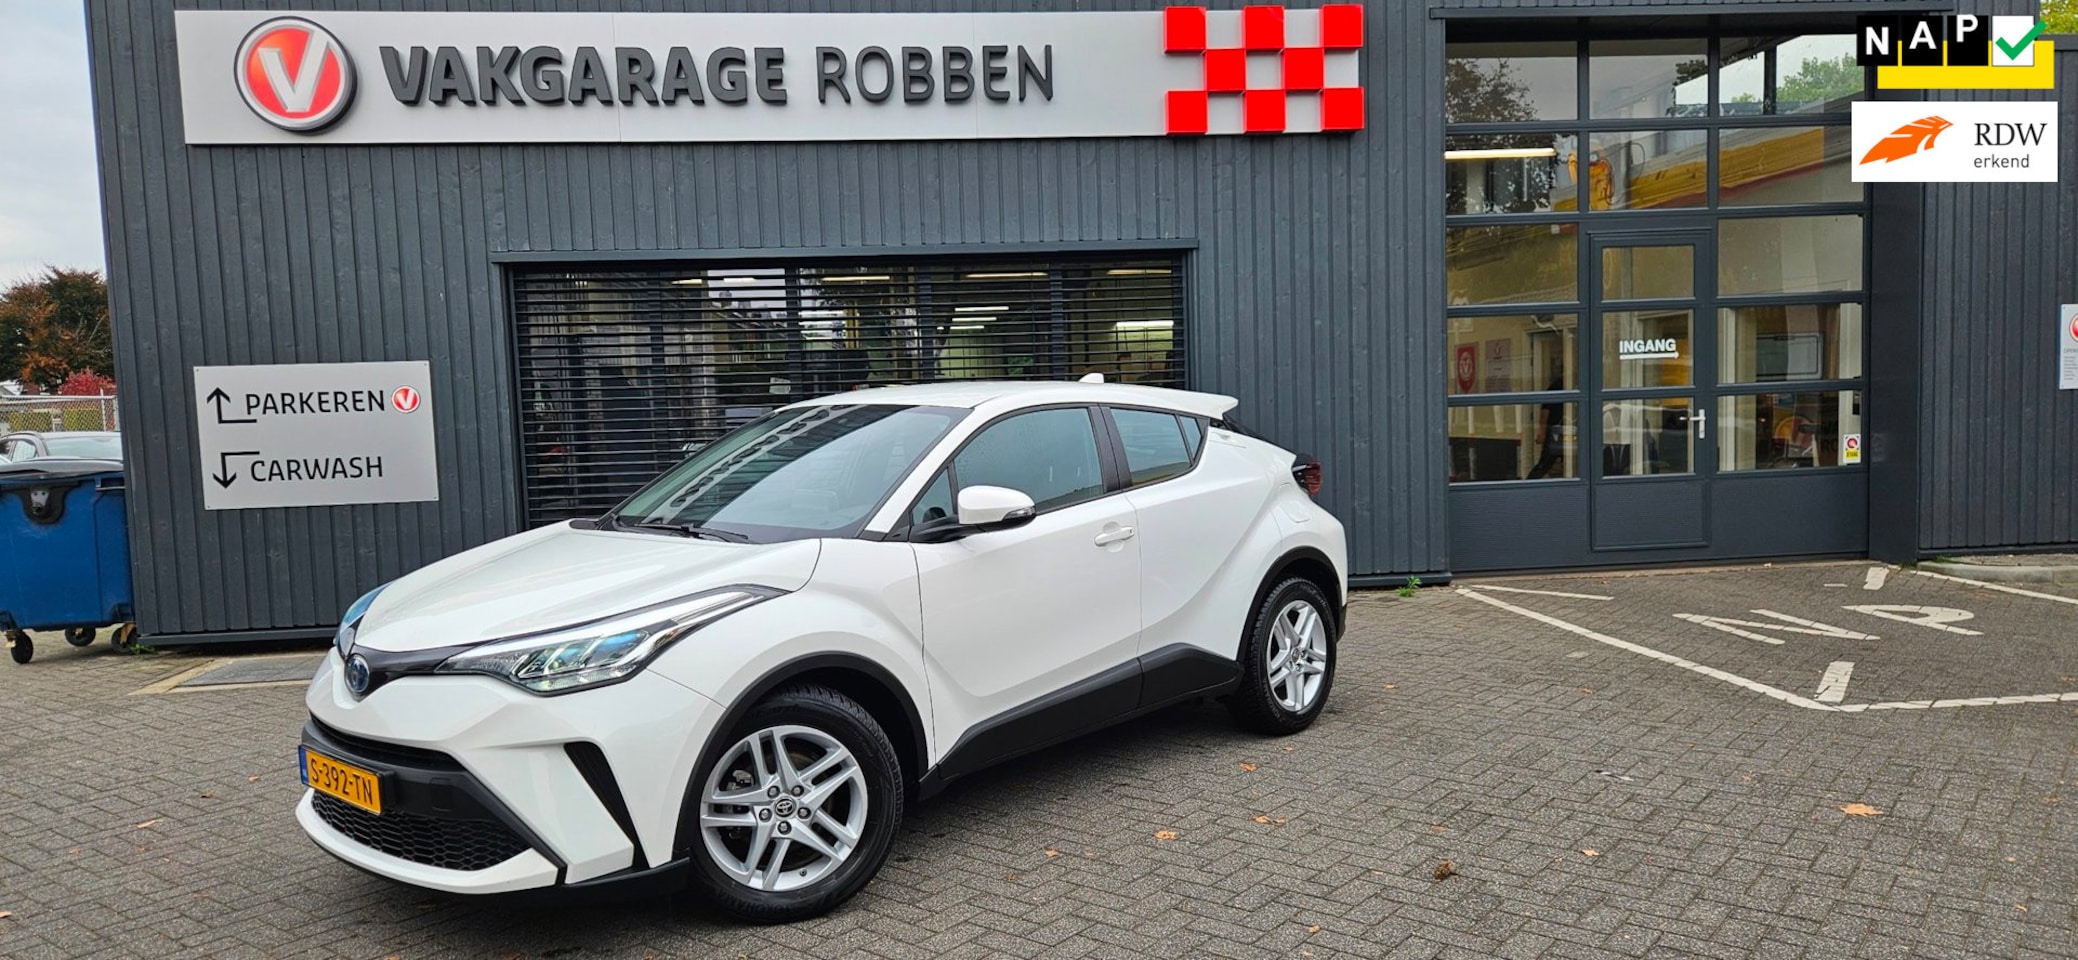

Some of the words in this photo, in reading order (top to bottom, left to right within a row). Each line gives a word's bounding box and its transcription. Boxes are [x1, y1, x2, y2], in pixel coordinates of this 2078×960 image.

[379, 45, 788, 106] VAKGARAGE
[815, 44, 1054, 104] ROBBEN
[1619, 338, 1677, 353] INGANG
[245, 389, 386, 415] PARKEREN
[250, 455, 384, 482] CARWASH
[310, 757, 374, 806] S-392-TN
